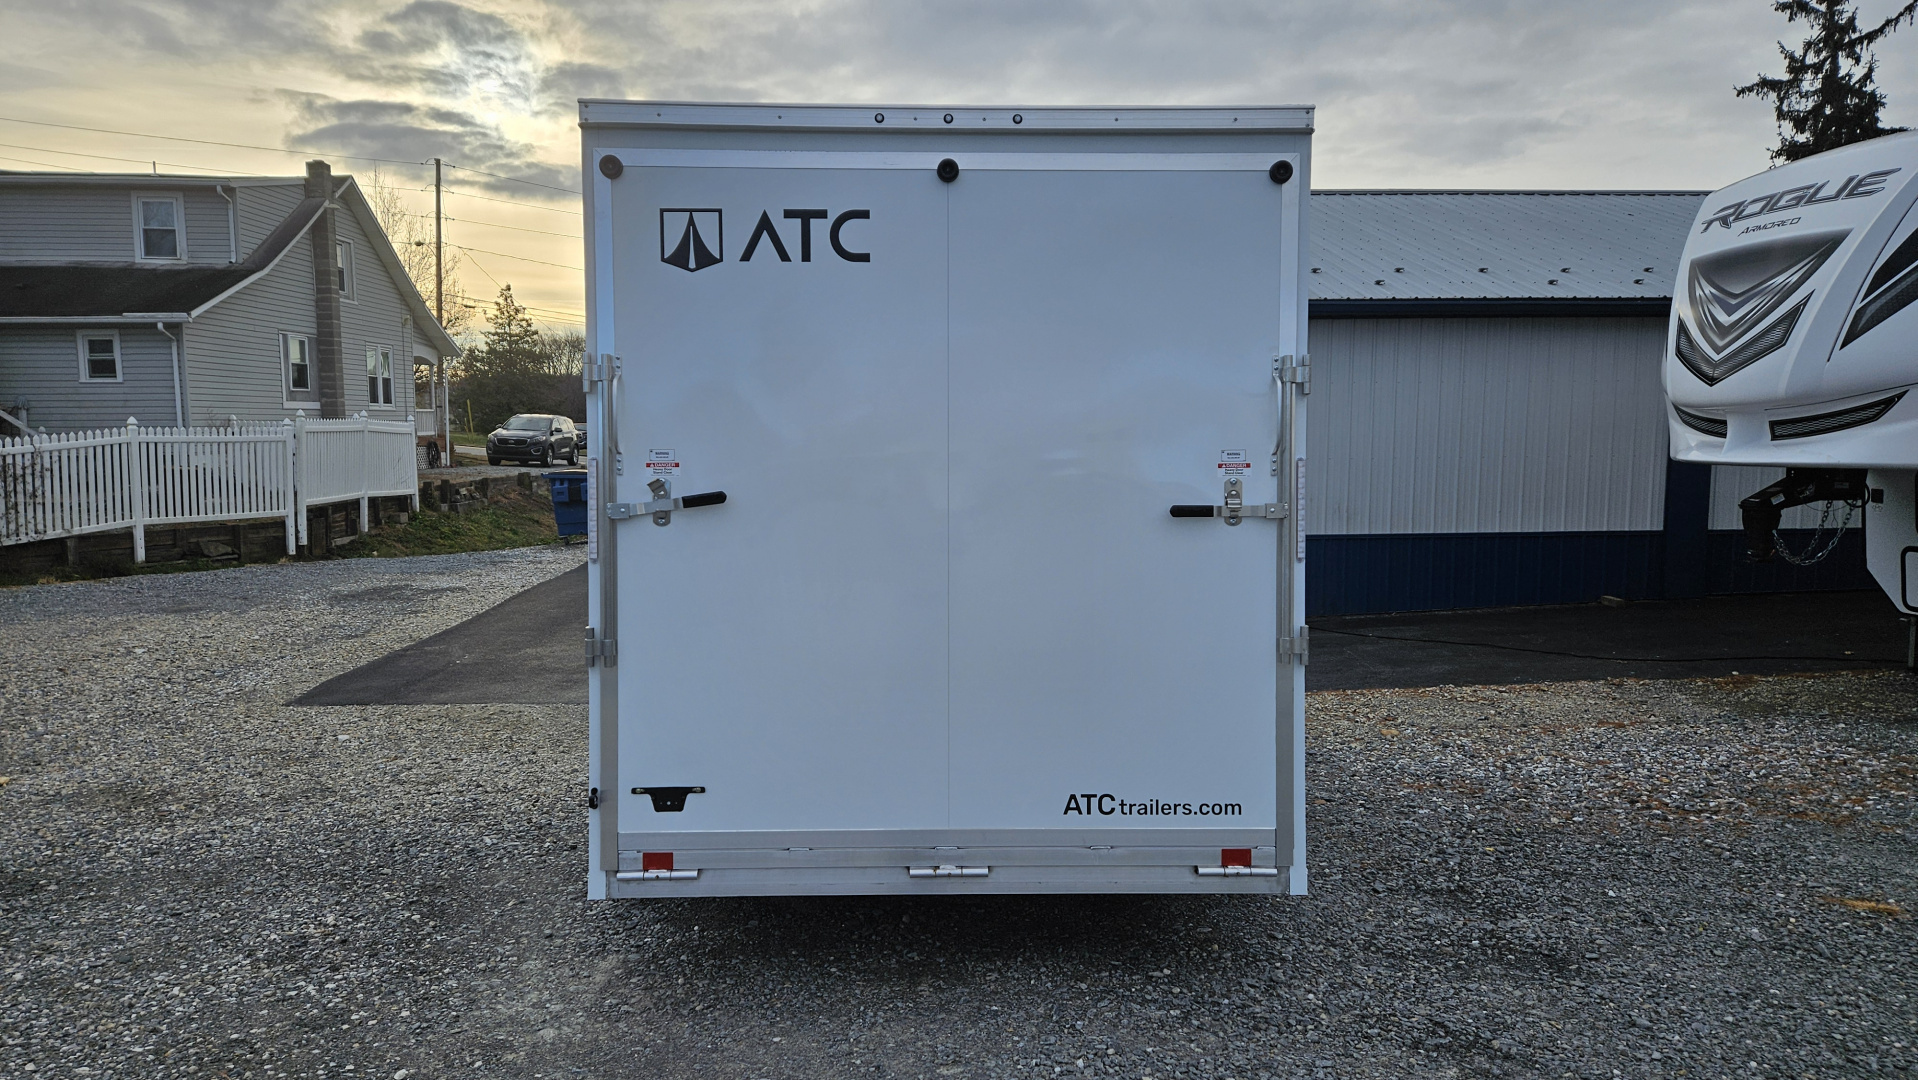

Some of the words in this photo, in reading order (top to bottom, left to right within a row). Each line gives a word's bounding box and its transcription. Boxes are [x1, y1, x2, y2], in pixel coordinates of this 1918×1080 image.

[1700, 167, 1902, 234] ROGUE
[1737, 216, 1802, 237] ARMORED
[739, 209, 871, 263] ATC
